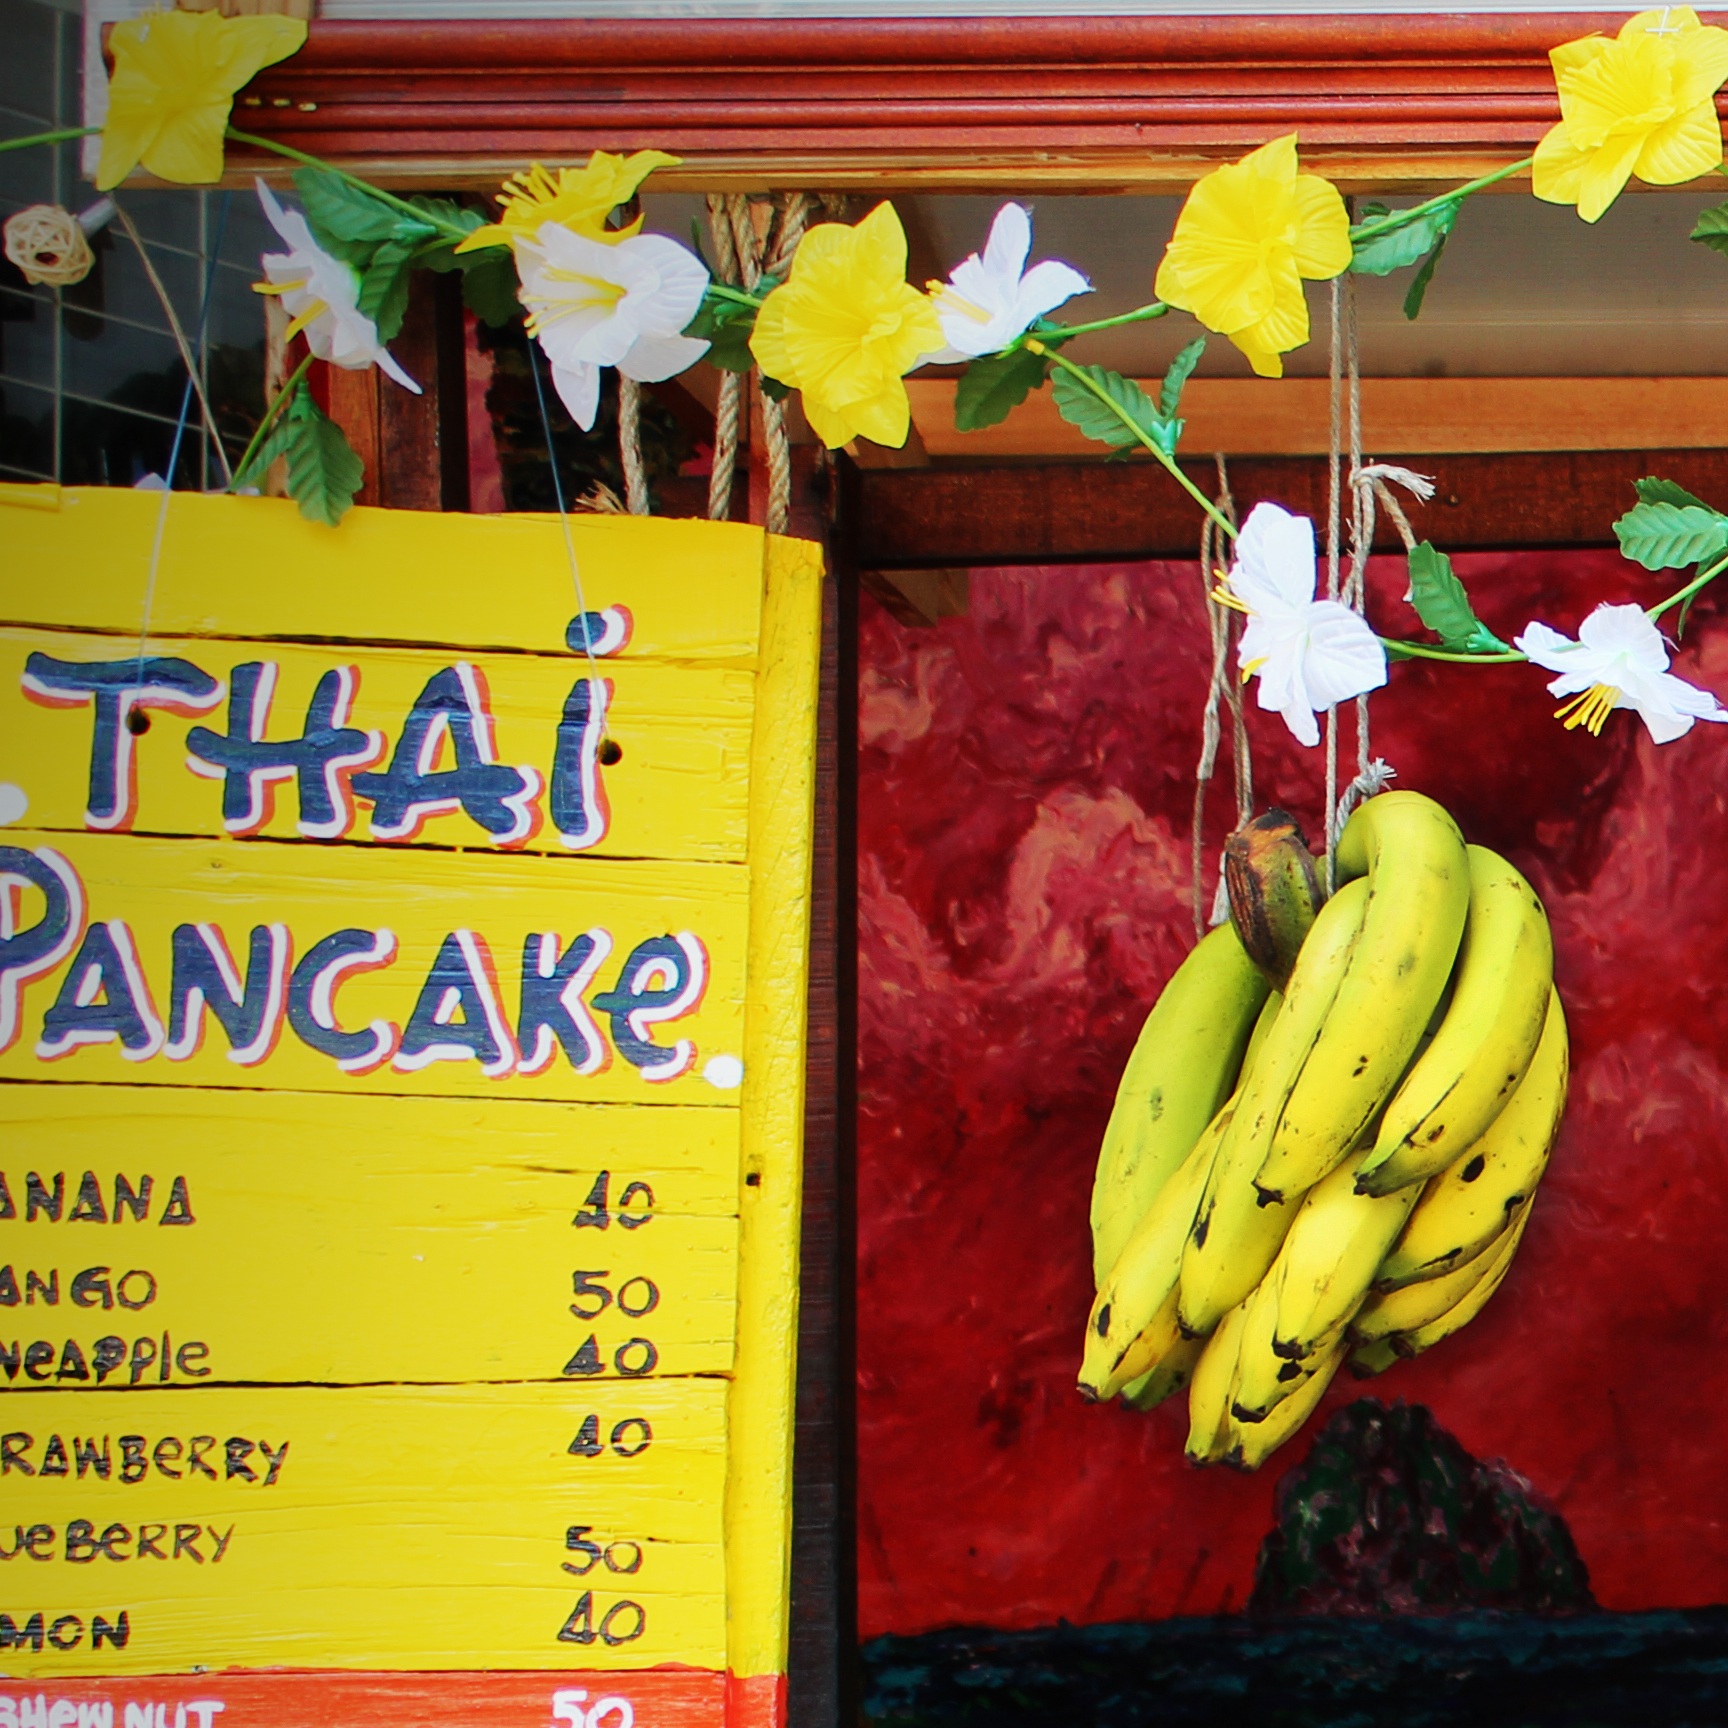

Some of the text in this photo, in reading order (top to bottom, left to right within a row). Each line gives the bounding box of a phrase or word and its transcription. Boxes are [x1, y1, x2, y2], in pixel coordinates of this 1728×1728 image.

[572, 1171, 655, 1230] 40
[569, 1269, 659, 1320] 50
[563, 1334, 659, 1377] 40
[567, 1414, 653, 1458] 40
[561, 1525, 643, 1576] 50
[556, 1591, 646, 1647] 40
